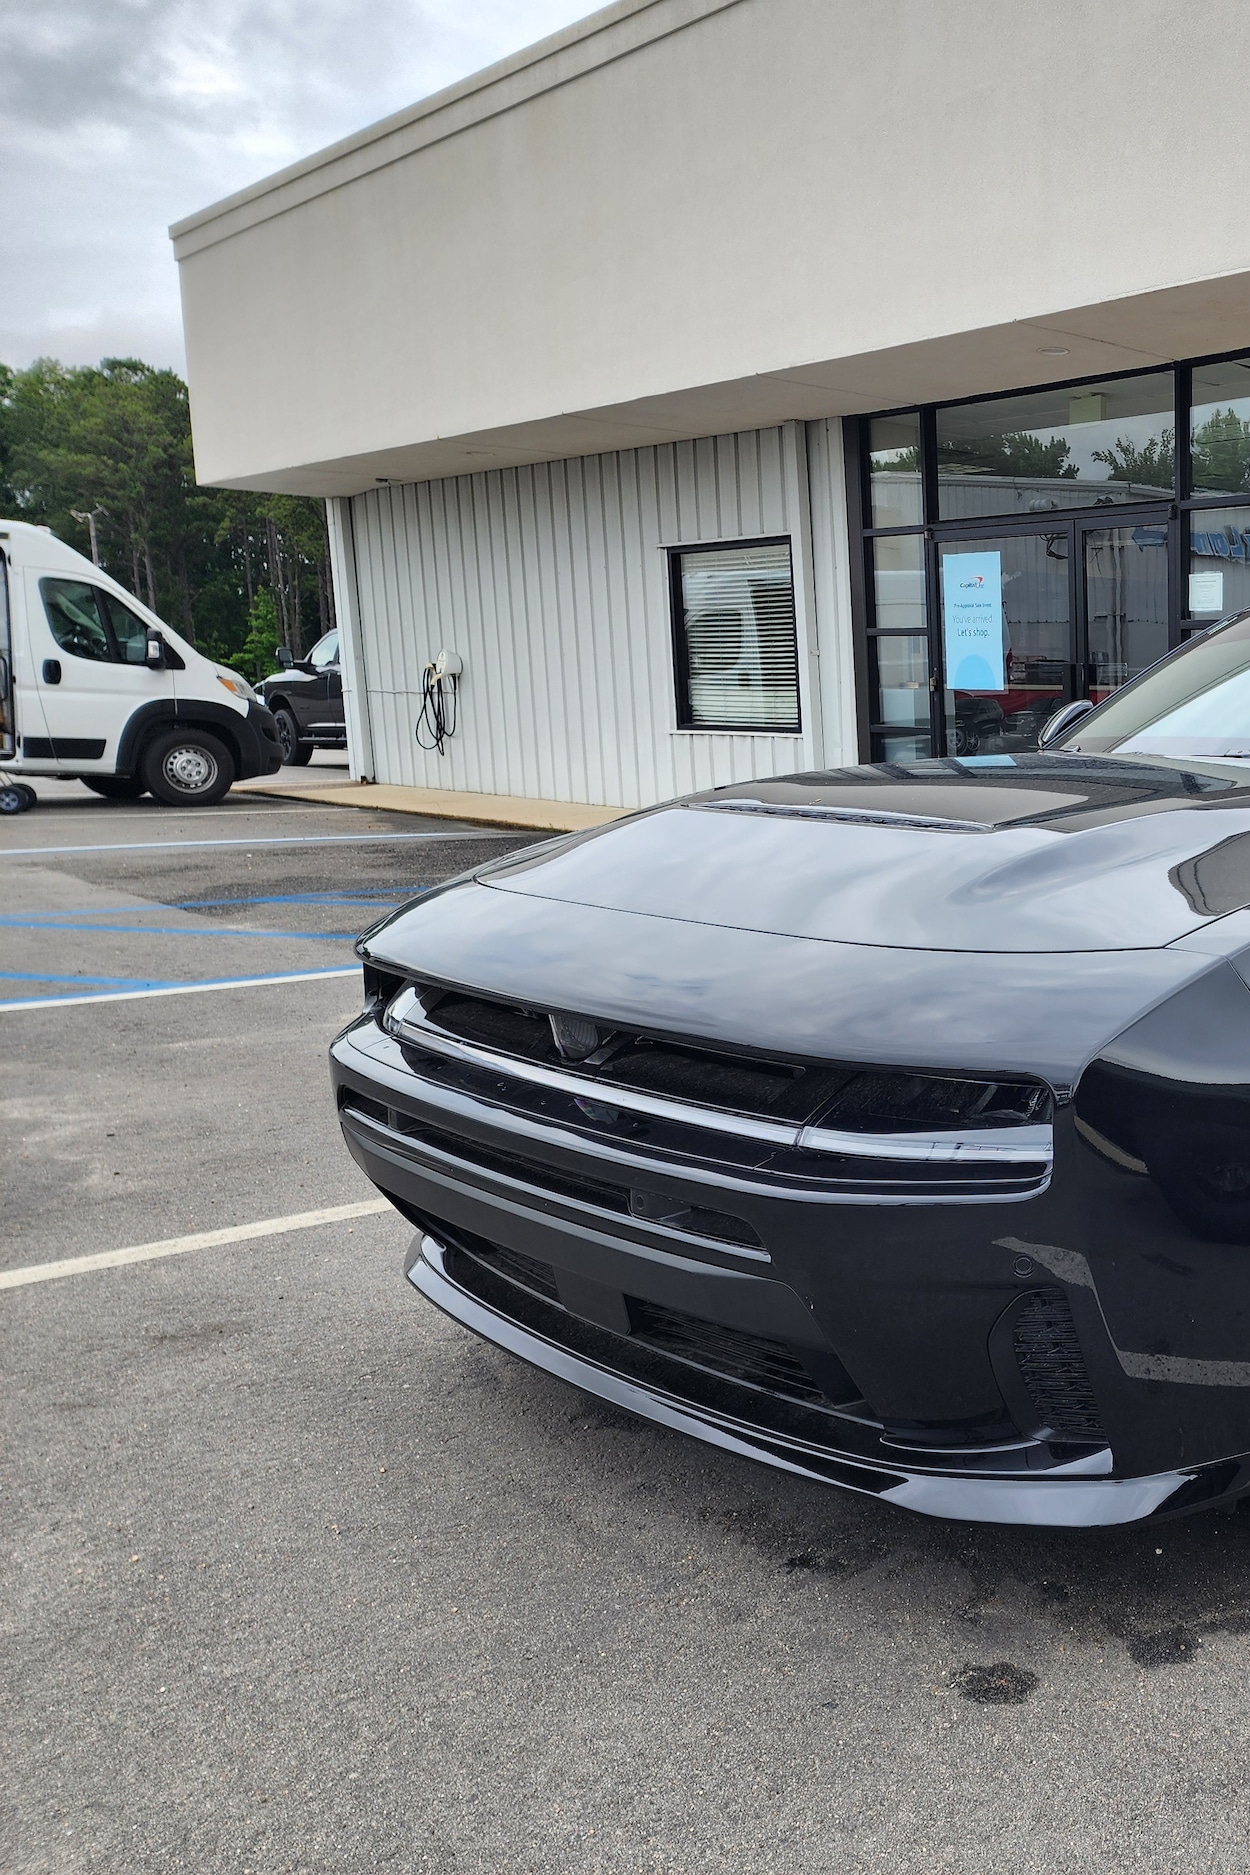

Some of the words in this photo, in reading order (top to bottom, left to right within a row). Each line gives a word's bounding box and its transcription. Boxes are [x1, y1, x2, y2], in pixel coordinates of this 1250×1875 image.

[952, 616, 971, 624] You've
[957, 628, 972, 637] Let's
[973, 628, 990, 638] shop.
